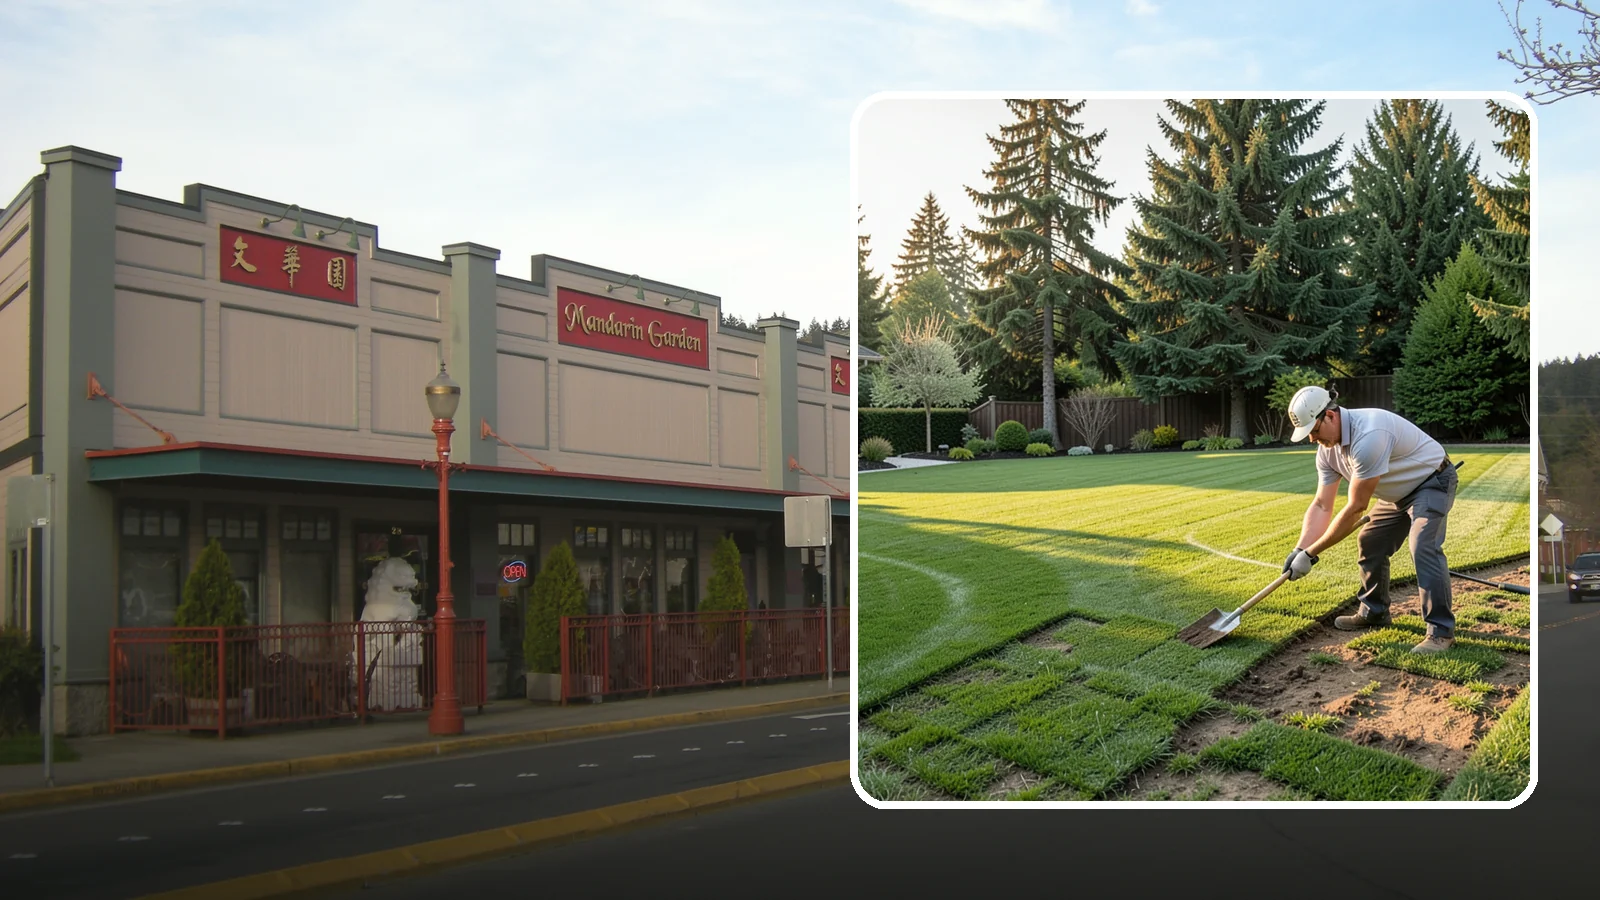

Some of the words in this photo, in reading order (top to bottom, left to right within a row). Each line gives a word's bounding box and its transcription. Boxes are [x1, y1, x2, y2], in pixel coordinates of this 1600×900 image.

[230, 235, 346, 291] 文華園
[564, 302, 644, 341] Mandarin
[647, 320, 701, 352] Garden
[503, 565, 527, 578] OPEN
